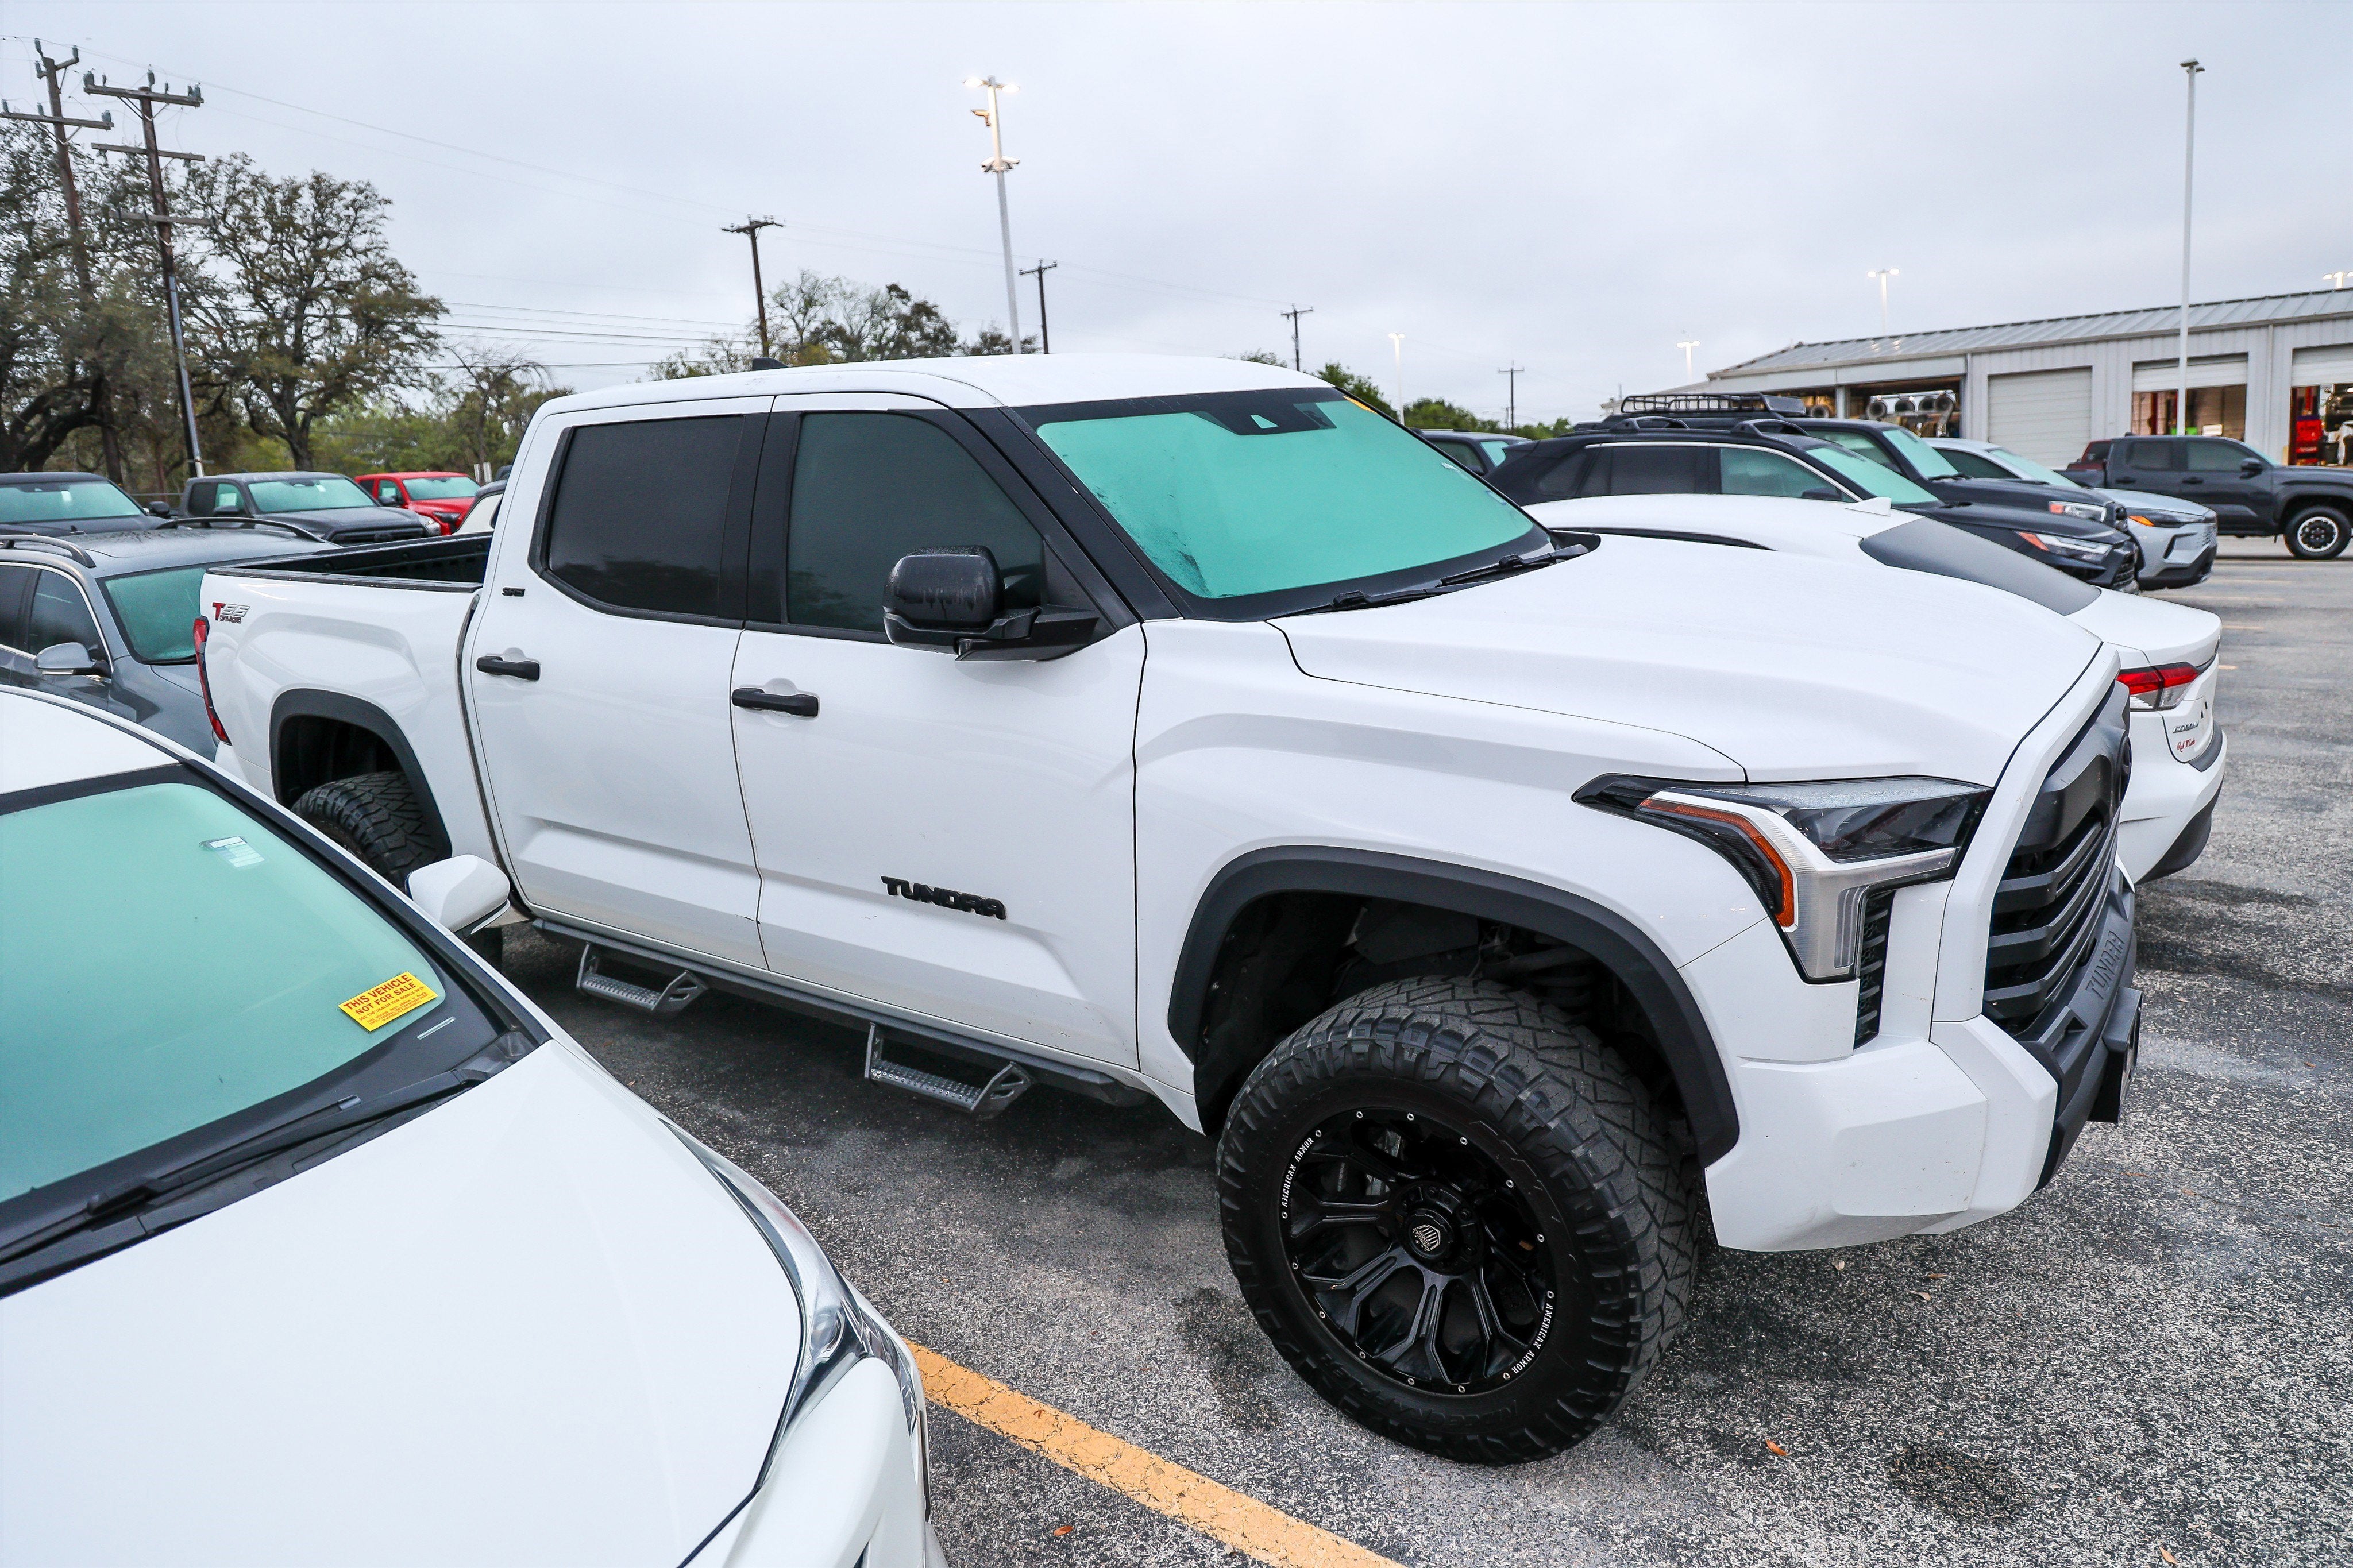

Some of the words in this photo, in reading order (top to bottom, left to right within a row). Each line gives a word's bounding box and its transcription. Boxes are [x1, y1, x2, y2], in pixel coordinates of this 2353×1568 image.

[880, 875, 1007, 920] TUNDRA
[2085, 930, 2125, 1001] TUNDRA
[344, 995, 371, 1010] THIS
[368, 975, 411, 998] VEHICLE
[355, 1003, 375, 1014] NOT
[374, 994, 394, 1005] FOR
[393, 982, 416, 995] SALE
[375, 1003, 392, 1012] DEALER
[1281, 1163, 1297, 1208] AMERICAN
[1294, 1137, 1314, 1162] ARMOR
[1413, 1228, 1431, 1252] AMERICAN
[1533, 1303, 1553, 1349] AMERICAN
[1511, 1350, 1535, 1374] ARMOR
